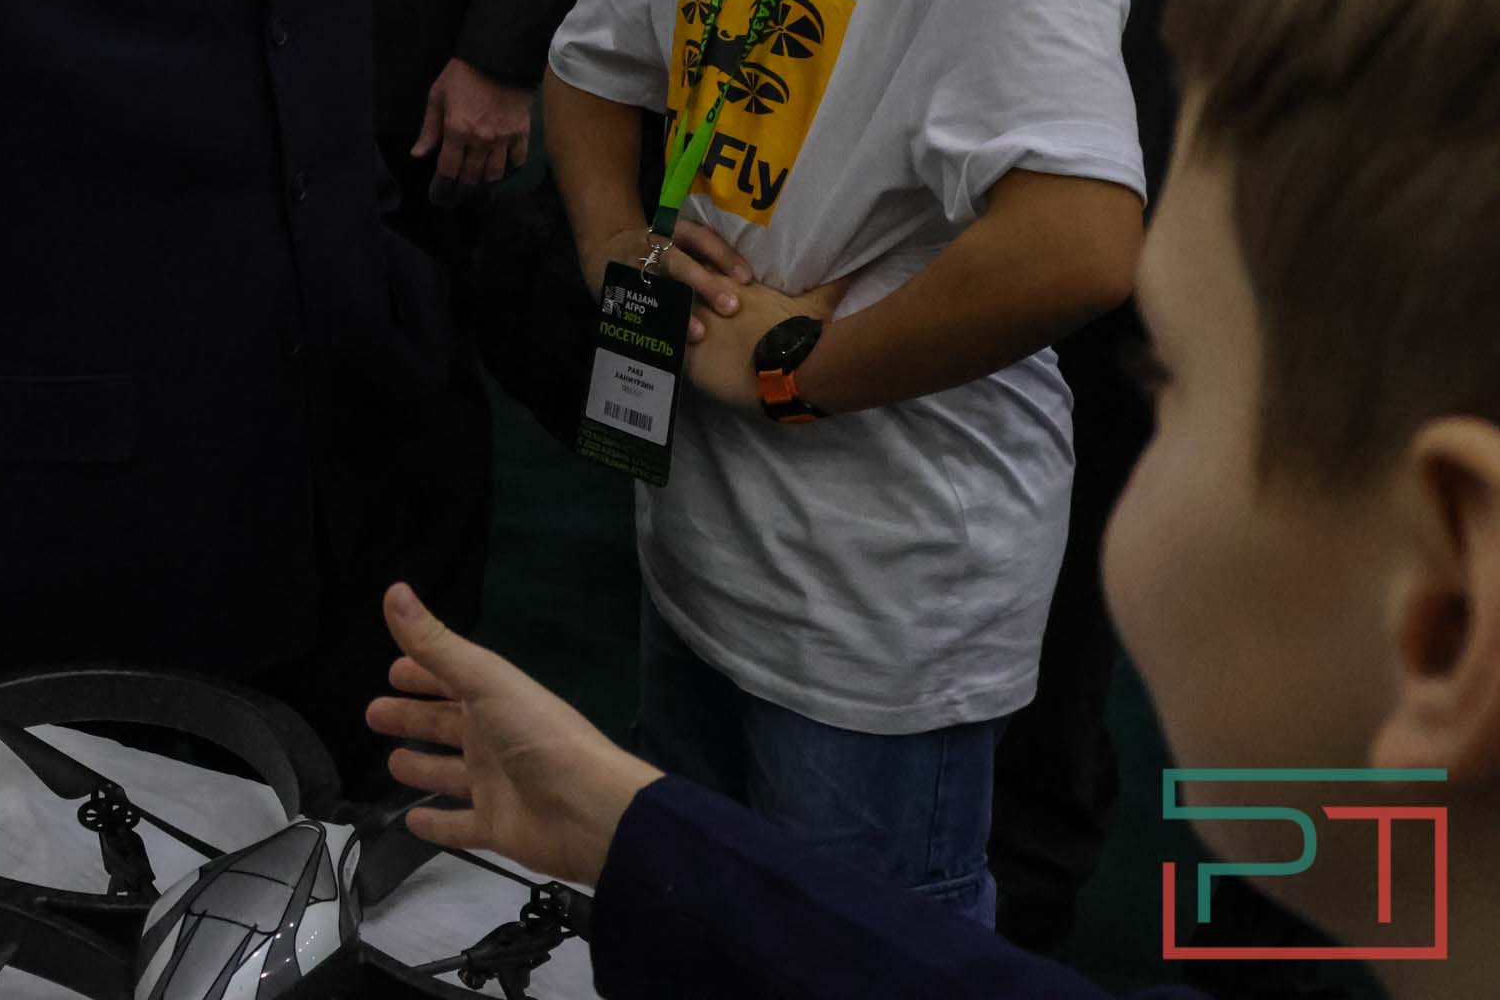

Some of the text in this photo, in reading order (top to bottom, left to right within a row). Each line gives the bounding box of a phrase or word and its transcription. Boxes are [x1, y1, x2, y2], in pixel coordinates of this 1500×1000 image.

[624, 301, 646, 315] АГРО
[626, 289, 660, 309] КАЗАНЬ
[600, 320, 675, 357] ПОСЕТИТЕЛЬ
